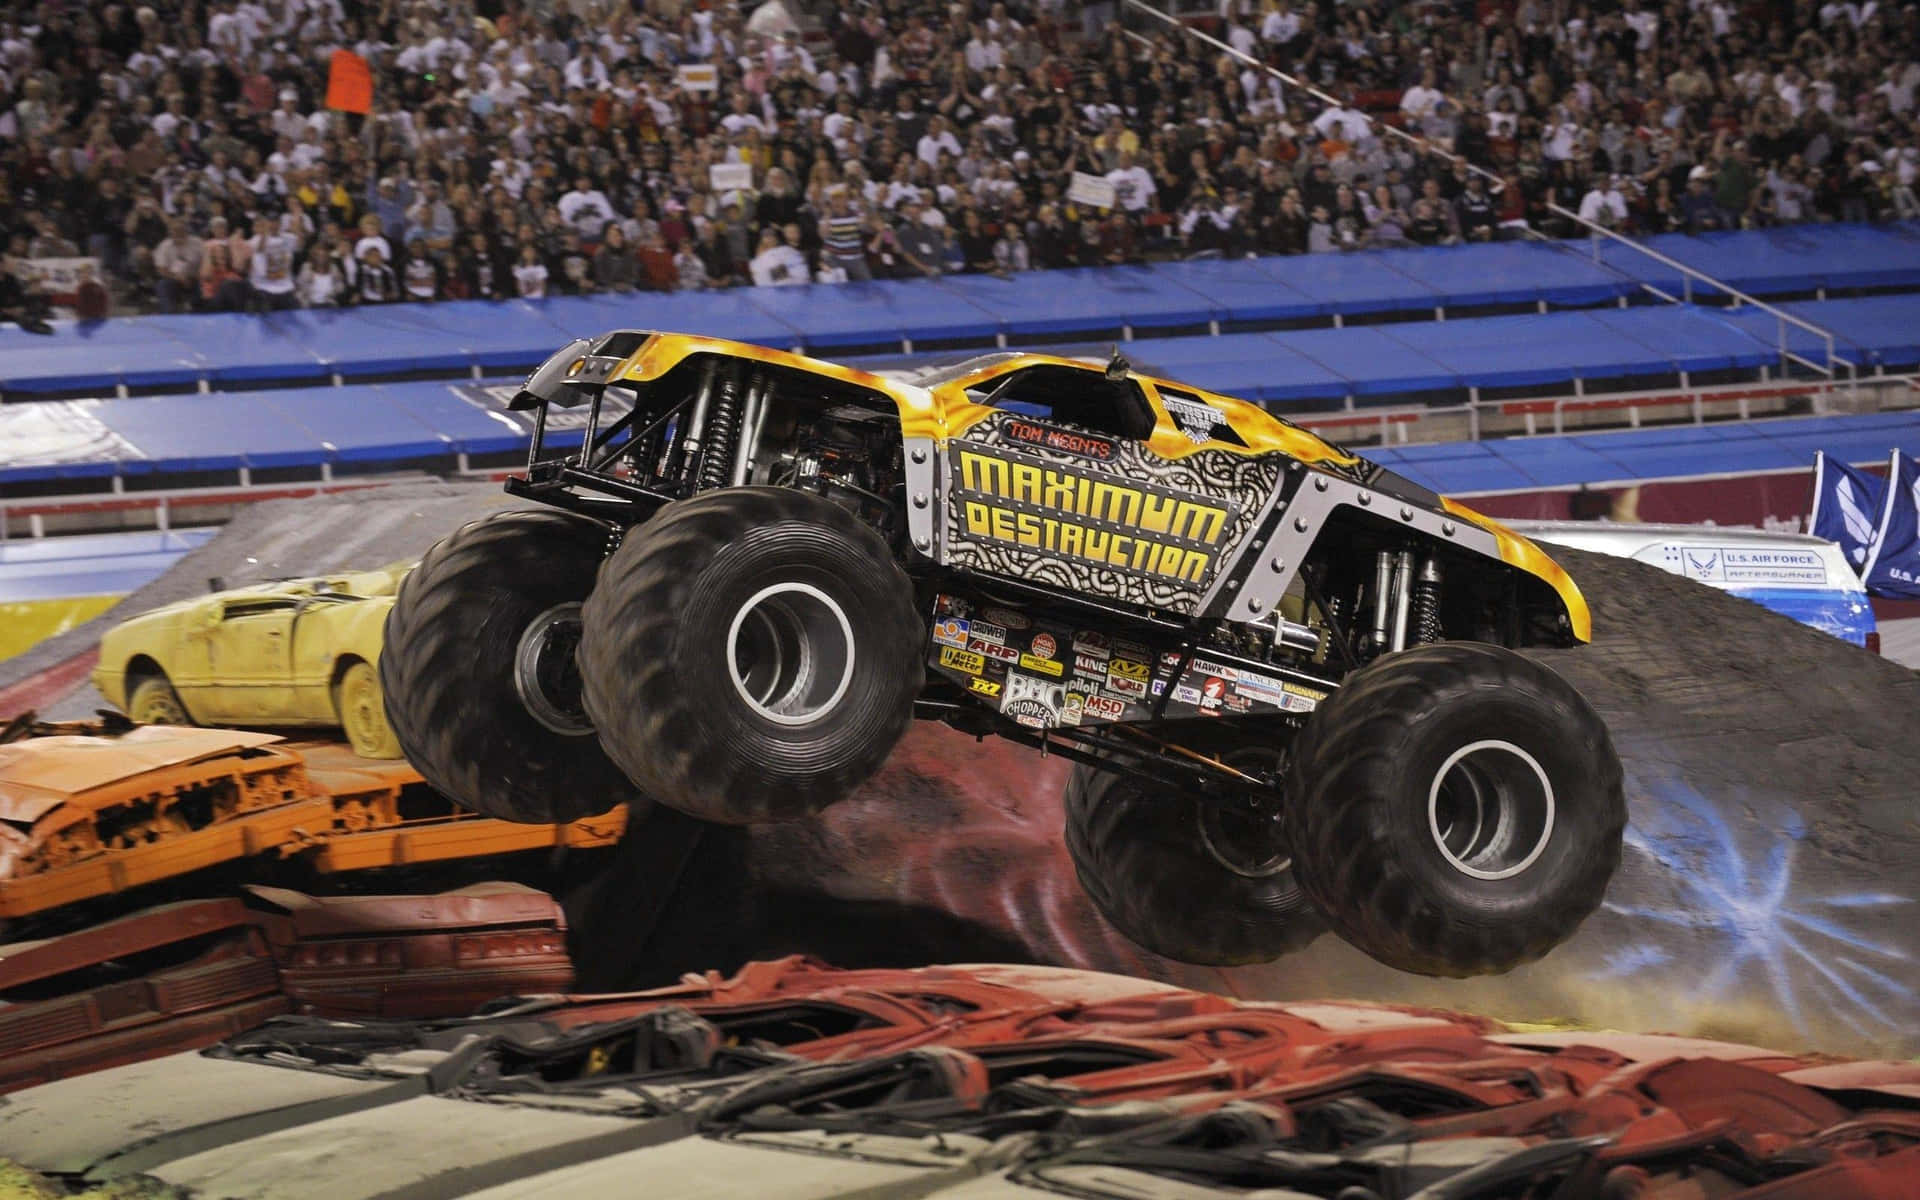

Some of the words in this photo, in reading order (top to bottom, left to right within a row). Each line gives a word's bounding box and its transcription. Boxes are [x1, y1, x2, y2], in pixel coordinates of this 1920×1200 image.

[1010, 421, 1043, 441] TOM
[1047, 431, 1111, 459] MEENTS
[959, 450, 1228, 546] MAXIMUM
[964, 500, 1210, 583] DESTRUCTION
[1727, 554, 1747, 563] U.S.
[1751, 554, 1771, 563] AIR
[1774, 555, 1814, 564] FORCE
[971, 621, 1005, 640] CROWER
[955, 651, 978, 663] Auto
[969, 641, 1018, 658] ARP
[952, 657, 982, 671] Meter
[1075, 655, 1107, 673] KING
[1193, 659, 1223, 674] HAWK
[1068, 677, 1100, 695] piloti
[1111, 676, 1144, 692] WORLD
[1086, 695, 1122, 714] MSD
[1006, 700, 1055, 729] CHOPPERS
